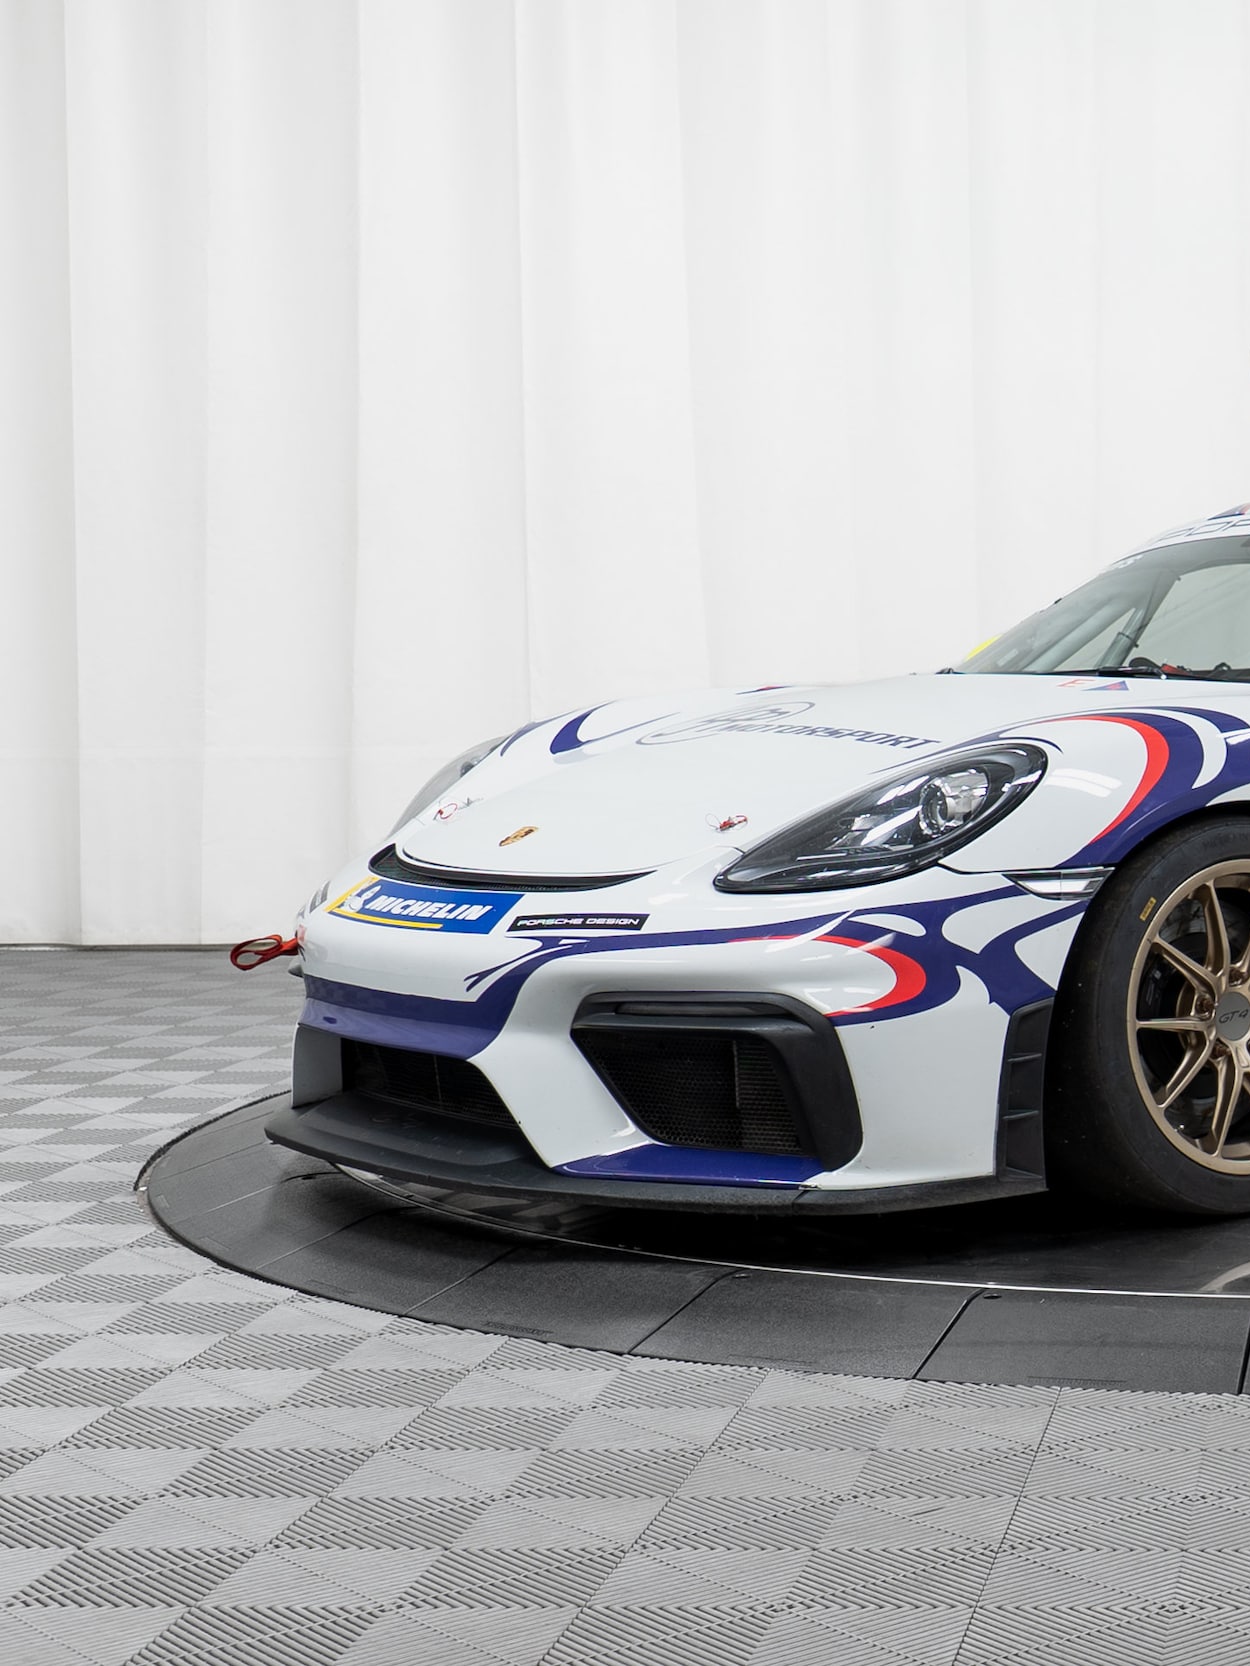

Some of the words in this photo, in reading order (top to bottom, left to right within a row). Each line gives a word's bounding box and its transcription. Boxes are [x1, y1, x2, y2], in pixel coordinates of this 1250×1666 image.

[717, 721, 943, 749] MOTORSPORT
[369, 894, 493, 922] MICHELIN
[516, 917, 584, 927] PORSCHE
[585, 917, 640, 926] DESIGN
[1218, 1008, 1249, 1024] GT4
